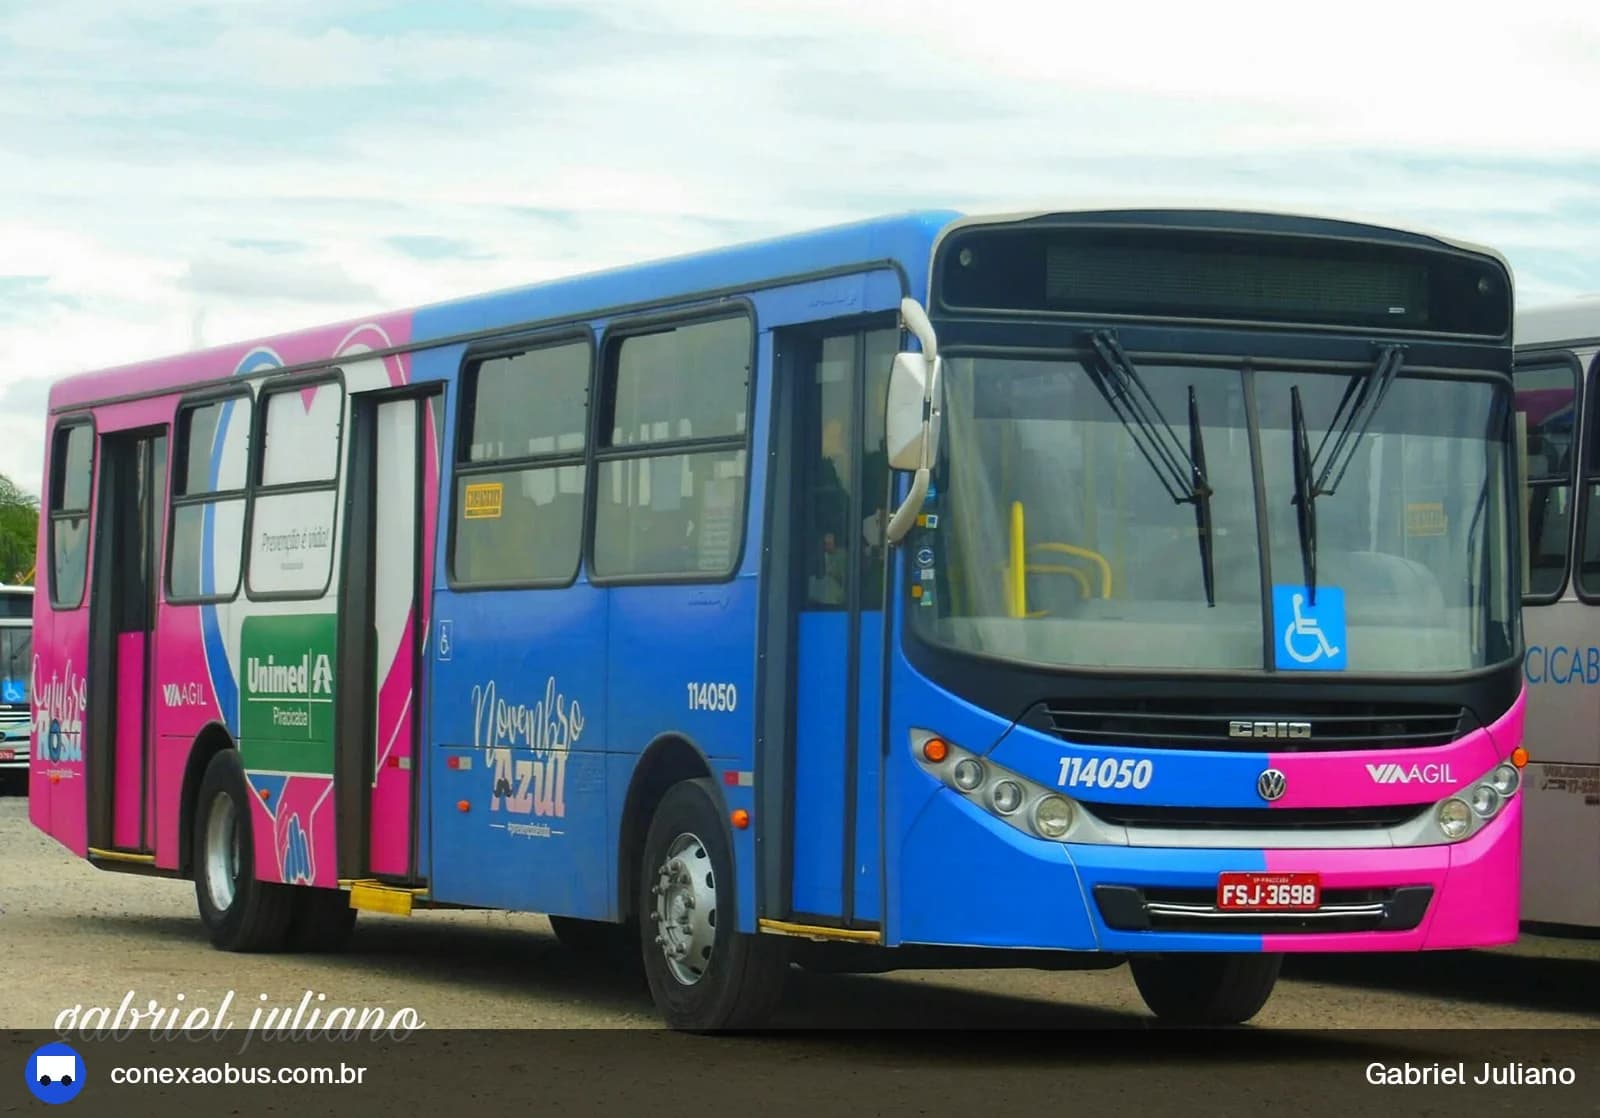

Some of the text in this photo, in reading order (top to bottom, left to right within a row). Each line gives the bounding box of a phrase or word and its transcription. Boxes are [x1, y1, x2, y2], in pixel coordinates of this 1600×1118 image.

[248, 655, 308, 694] Unimed
[687, 682, 737, 712] 114050
[273, 706, 308, 726] Piracicaba
[471, 676, 584, 767] Novembro
[1229, 721, 1311, 738] CAIO
[1057, 757, 1153, 790] 114050
